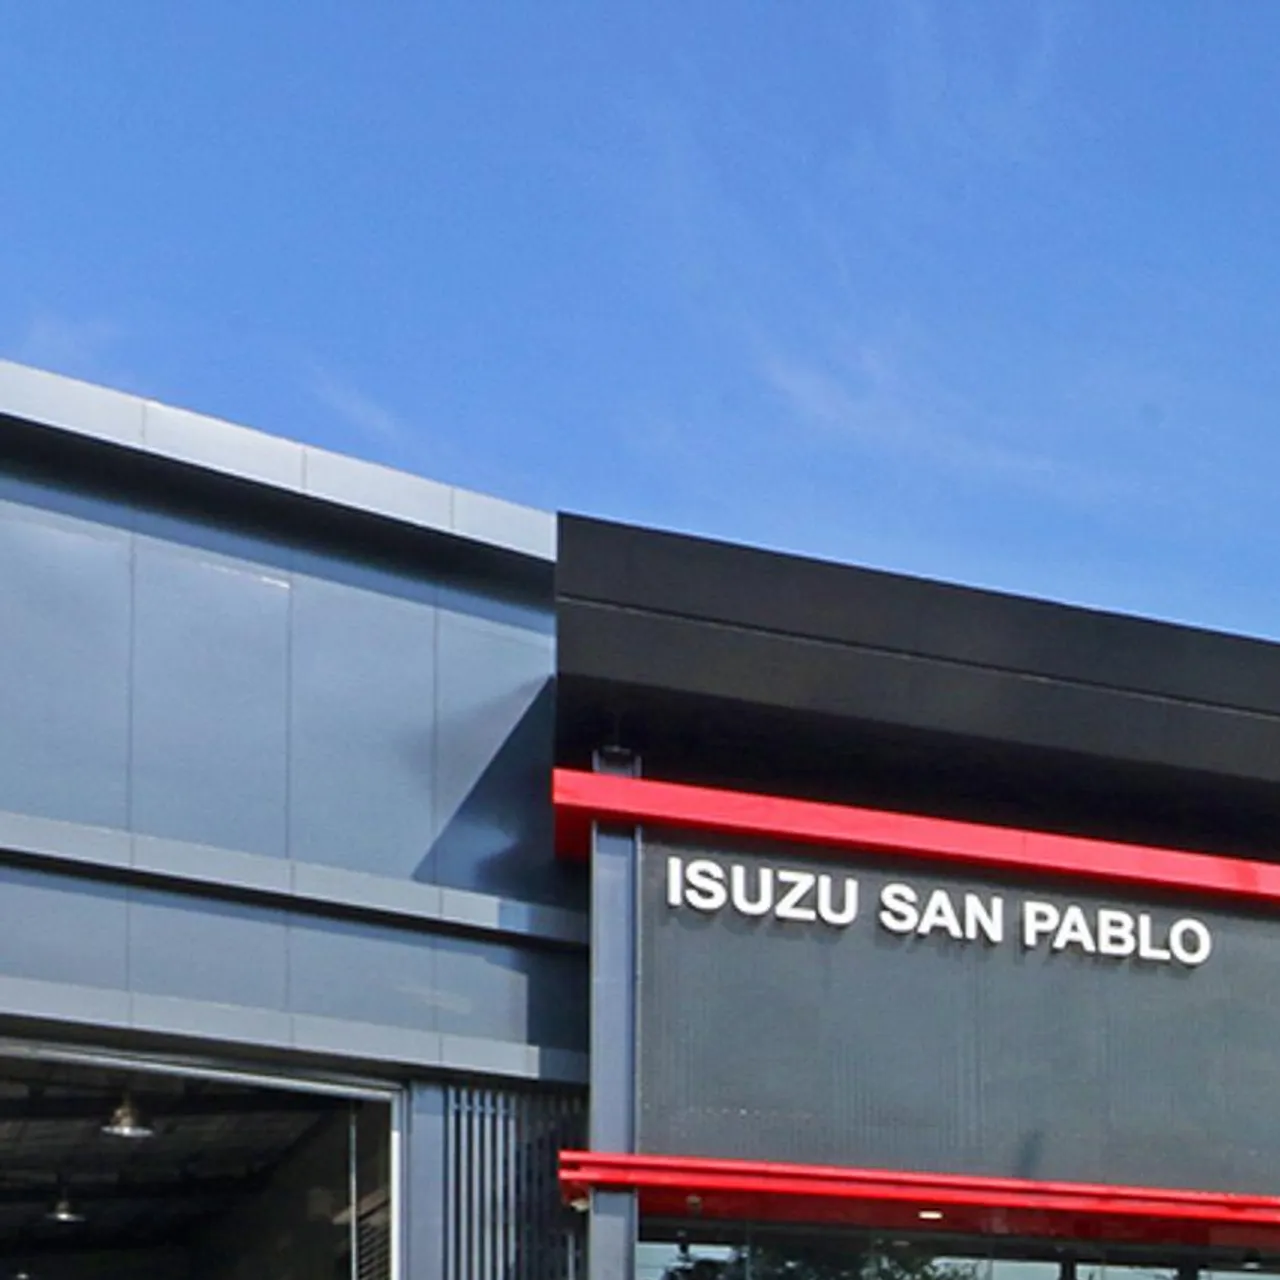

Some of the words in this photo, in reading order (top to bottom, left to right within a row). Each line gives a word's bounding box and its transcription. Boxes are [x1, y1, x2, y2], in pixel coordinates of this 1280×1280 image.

[667, 856, 859, 925] ISUZU
[879, 882, 1004, 943] SAN
[1023, 900, 1212, 965] PABLO
